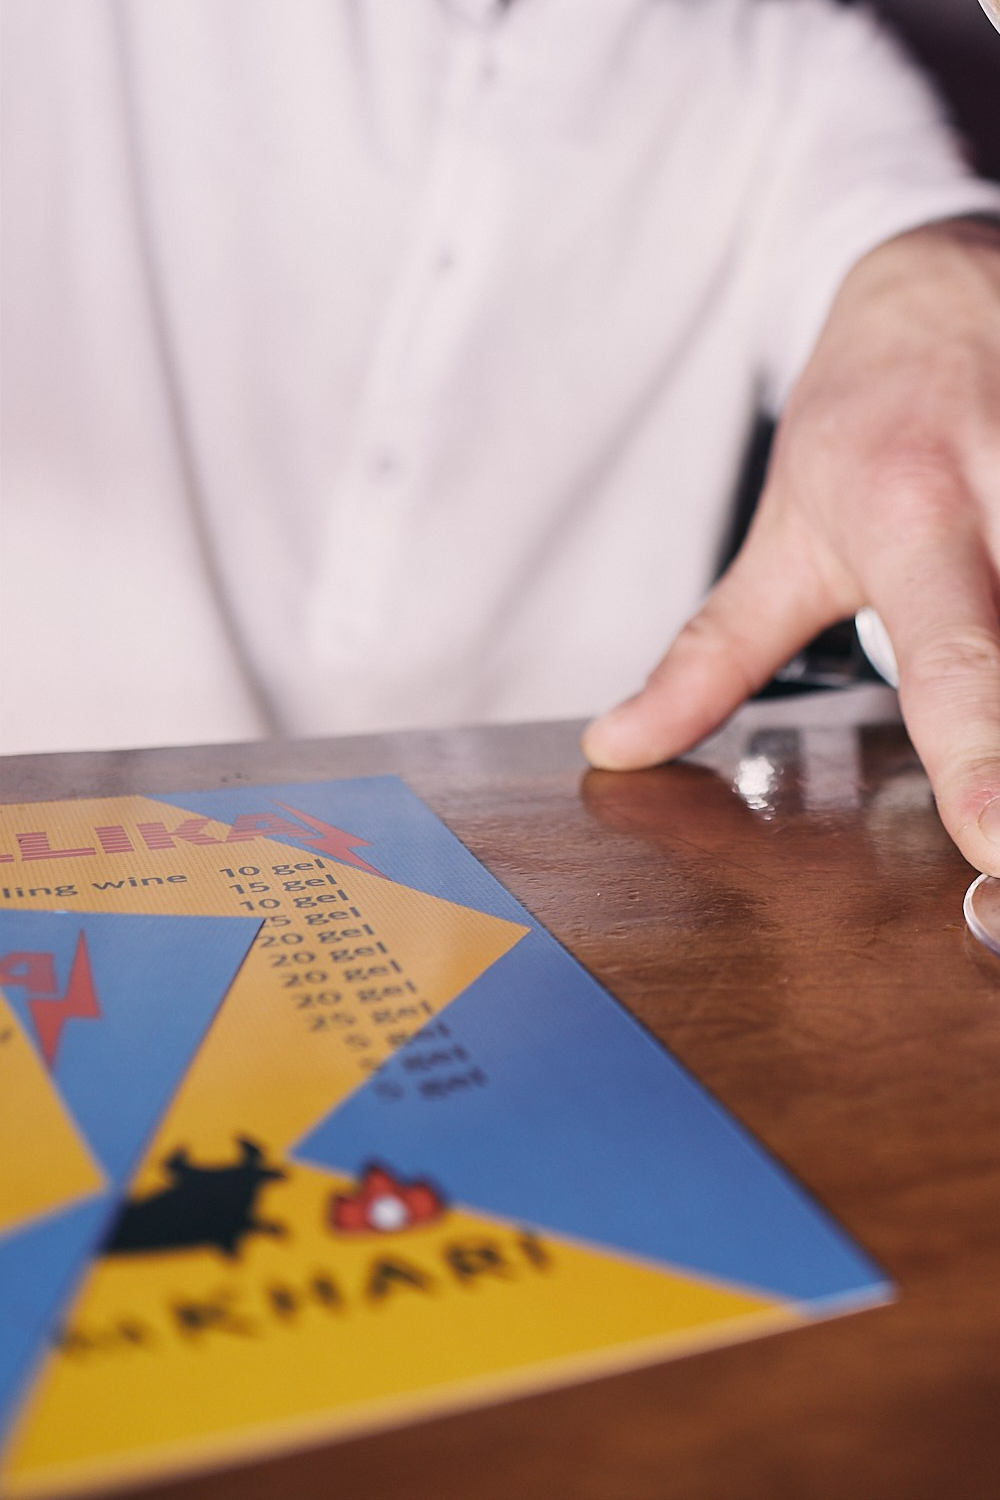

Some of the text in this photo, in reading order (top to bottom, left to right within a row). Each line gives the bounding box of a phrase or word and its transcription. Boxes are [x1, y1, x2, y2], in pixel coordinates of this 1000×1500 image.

[91, 874, 188, 890] wine
[219, 866, 260, 878] 10
[272, 859, 325, 875] gel
[229, 874, 337, 895] 15 gel
[239, 889, 349, 911] 10 gel
[304, 906, 361, 926] gel
[256, 924, 374, 948] 20 gel
[269, 941, 388, 967] 20 gel
[281, 959, 402, 988] 20 gel
[356, 980, 417, 1002] gel
